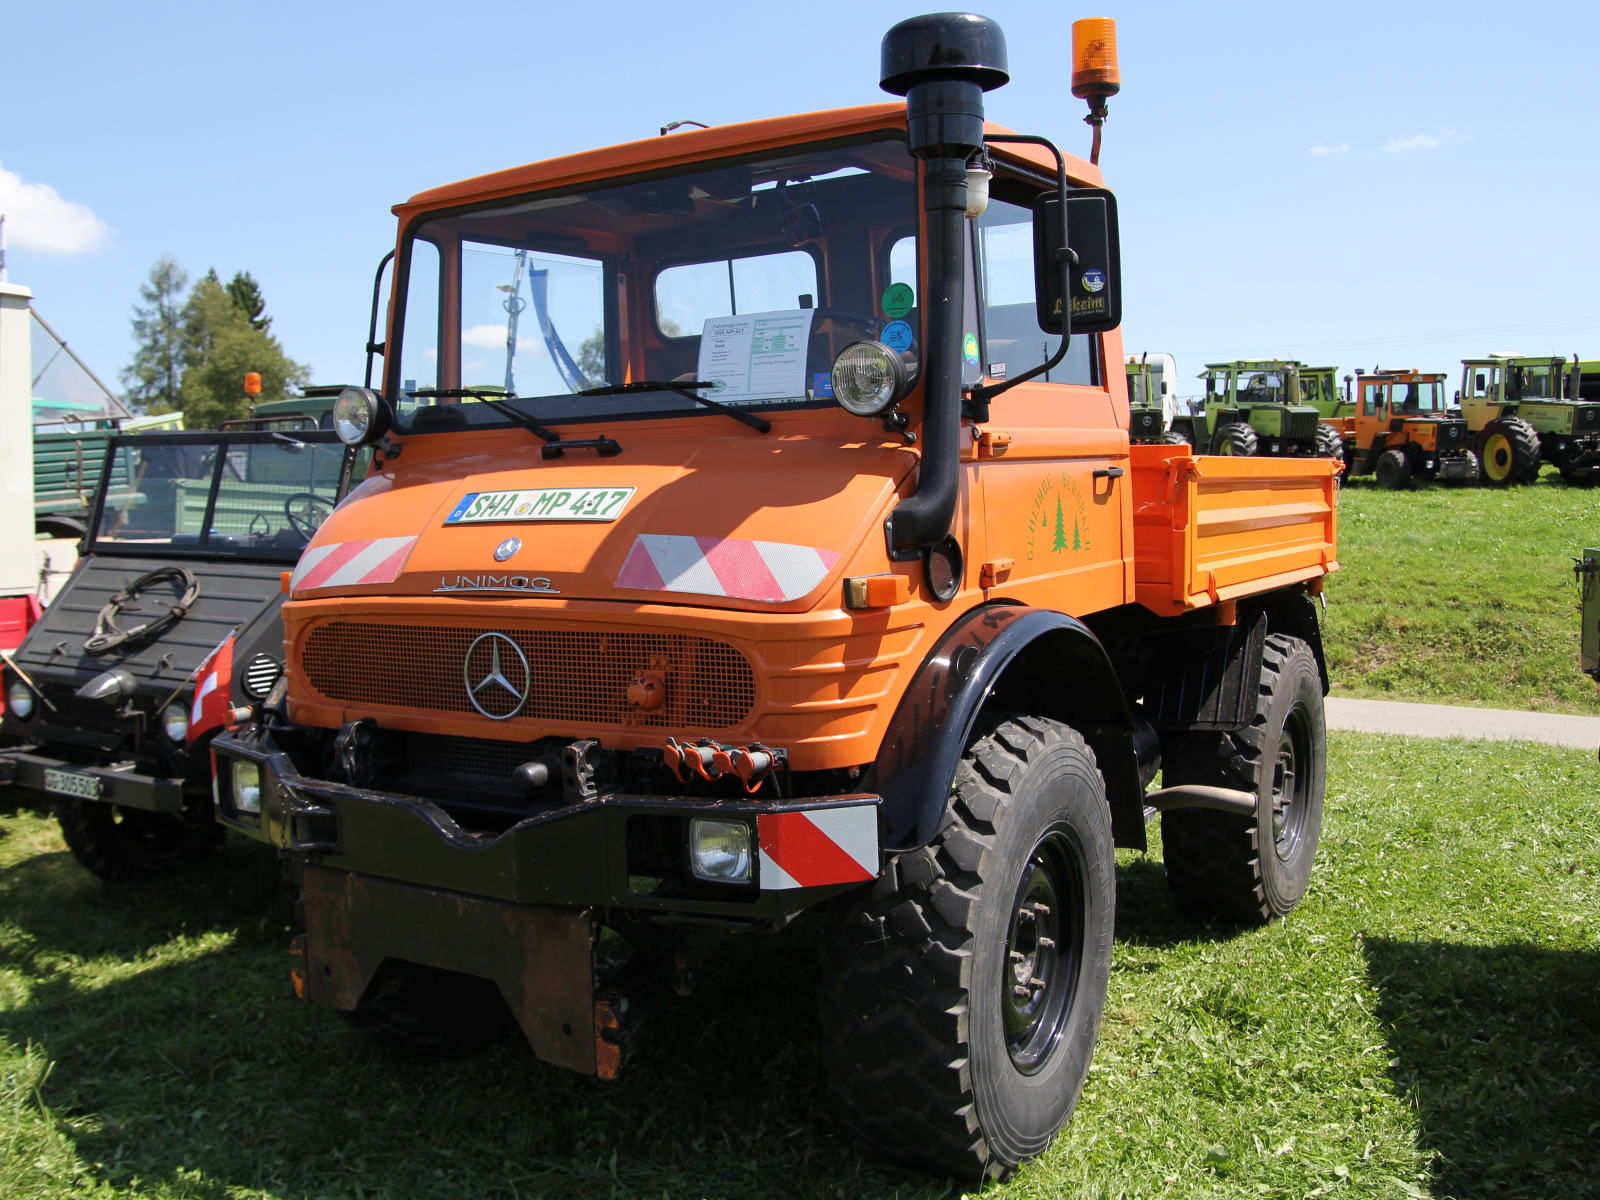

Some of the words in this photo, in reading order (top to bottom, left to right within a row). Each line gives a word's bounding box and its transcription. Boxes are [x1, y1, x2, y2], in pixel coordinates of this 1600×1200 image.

[713, 321, 749, 329] Fahrzeugschein
[465, 493, 519, 518] SHA
[528, 491, 572, 515] MP
[569, 491, 629, 515] 417
[441, 575, 552, 589] UNIMOG
